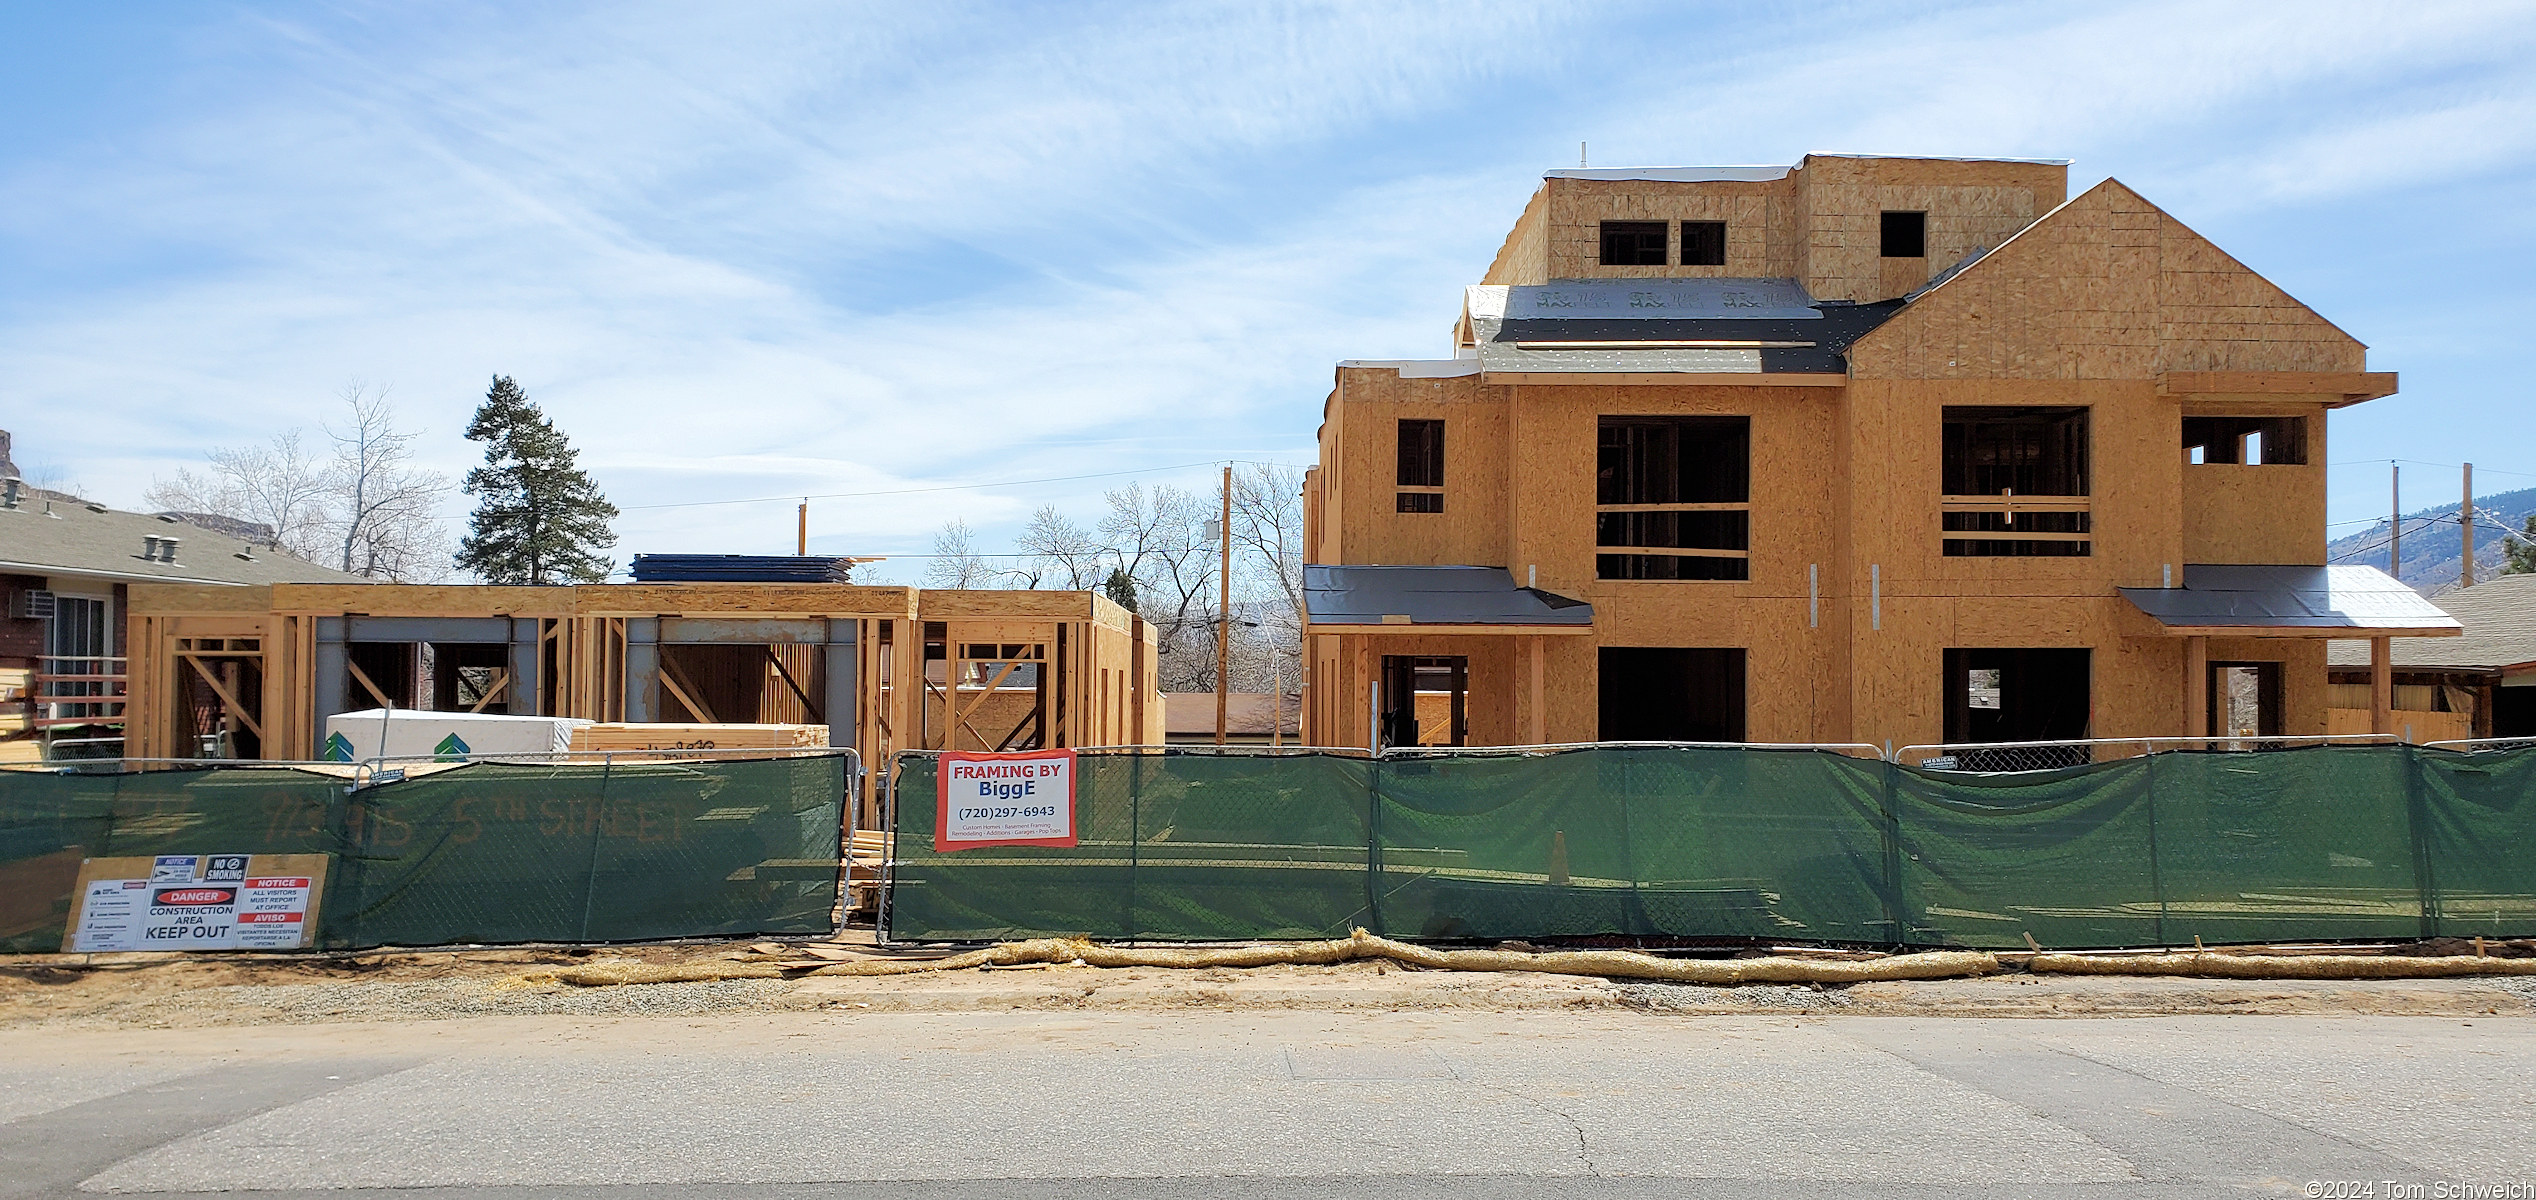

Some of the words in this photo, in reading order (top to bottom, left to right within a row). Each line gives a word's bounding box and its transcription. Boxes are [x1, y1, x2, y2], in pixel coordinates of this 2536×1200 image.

[371, 769, 404, 777] AMERICAN
[954, 765, 1034, 779] FRAMING
[1039, 764, 1062, 777] BY
[979, 780, 1035, 799] BiggE
[959, 806, 1055, 820] (720)297-6943
[539, 796, 684, 842] STREET
[213, 859, 226, 869] NO
[207, 870, 242, 880] SMOKING
[257, 879, 296, 887] NOTICE
[170, 892, 219, 902] DANGER
[149, 906, 233, 916] CONSTRUCTION
[174, 916, 203, 924] AREA
[253, 914, 286, 922] AVISO
[145, 926, 188, 939] KEEP
[193, 926, 229, 939] OUT
